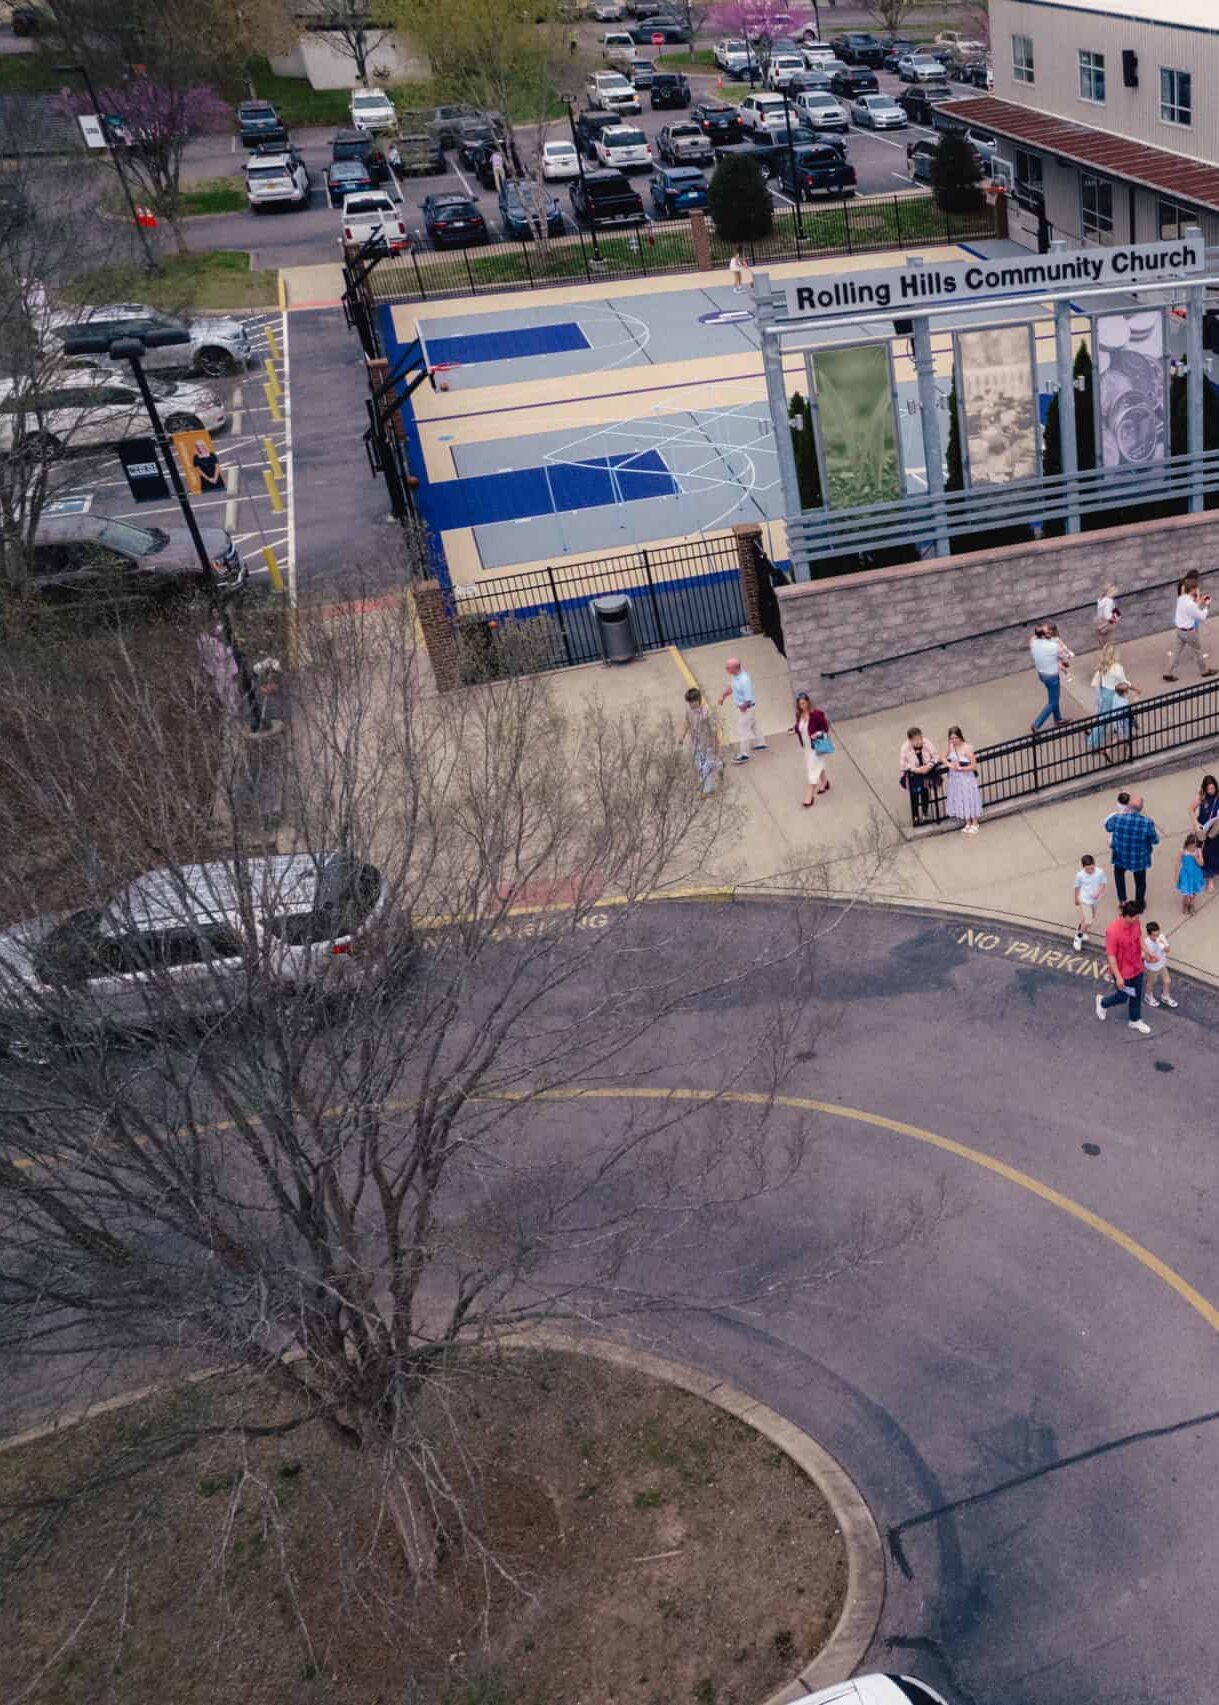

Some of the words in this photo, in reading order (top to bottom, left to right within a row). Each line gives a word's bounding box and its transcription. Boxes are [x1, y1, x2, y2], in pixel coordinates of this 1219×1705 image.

[797, 280, 891, 310] Rolling
[900, 271, 957, 298] Hills
[965, 258, 1104, 291] Community
[1112, 245, 1197, 273] Church
[957, 928, 1000, 950] NO
